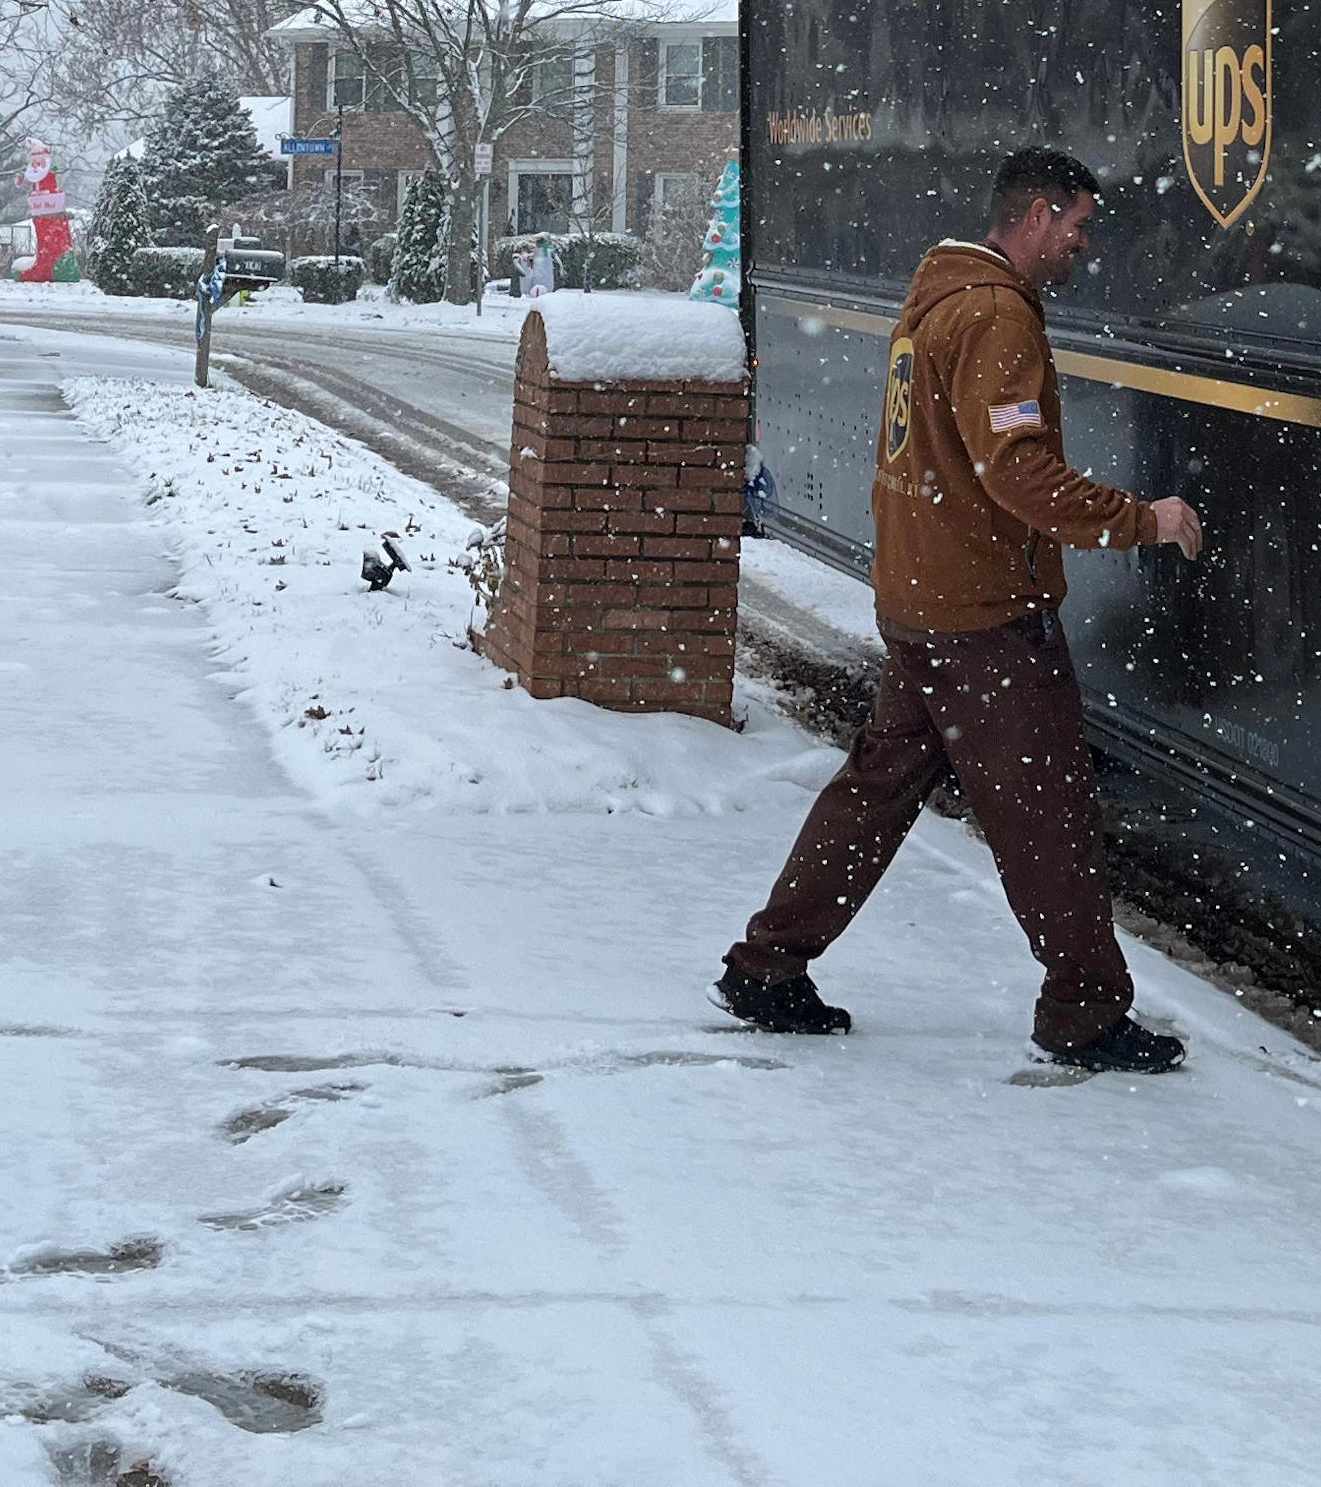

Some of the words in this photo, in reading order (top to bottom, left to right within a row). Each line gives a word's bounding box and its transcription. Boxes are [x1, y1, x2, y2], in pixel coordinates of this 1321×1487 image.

[768, 108, 822, 145] Worldwide
[824, 105, 872, 143] Services
[1188, 44, 1265, 186] ups
[1215, 715, 1245, 749] USDOT
